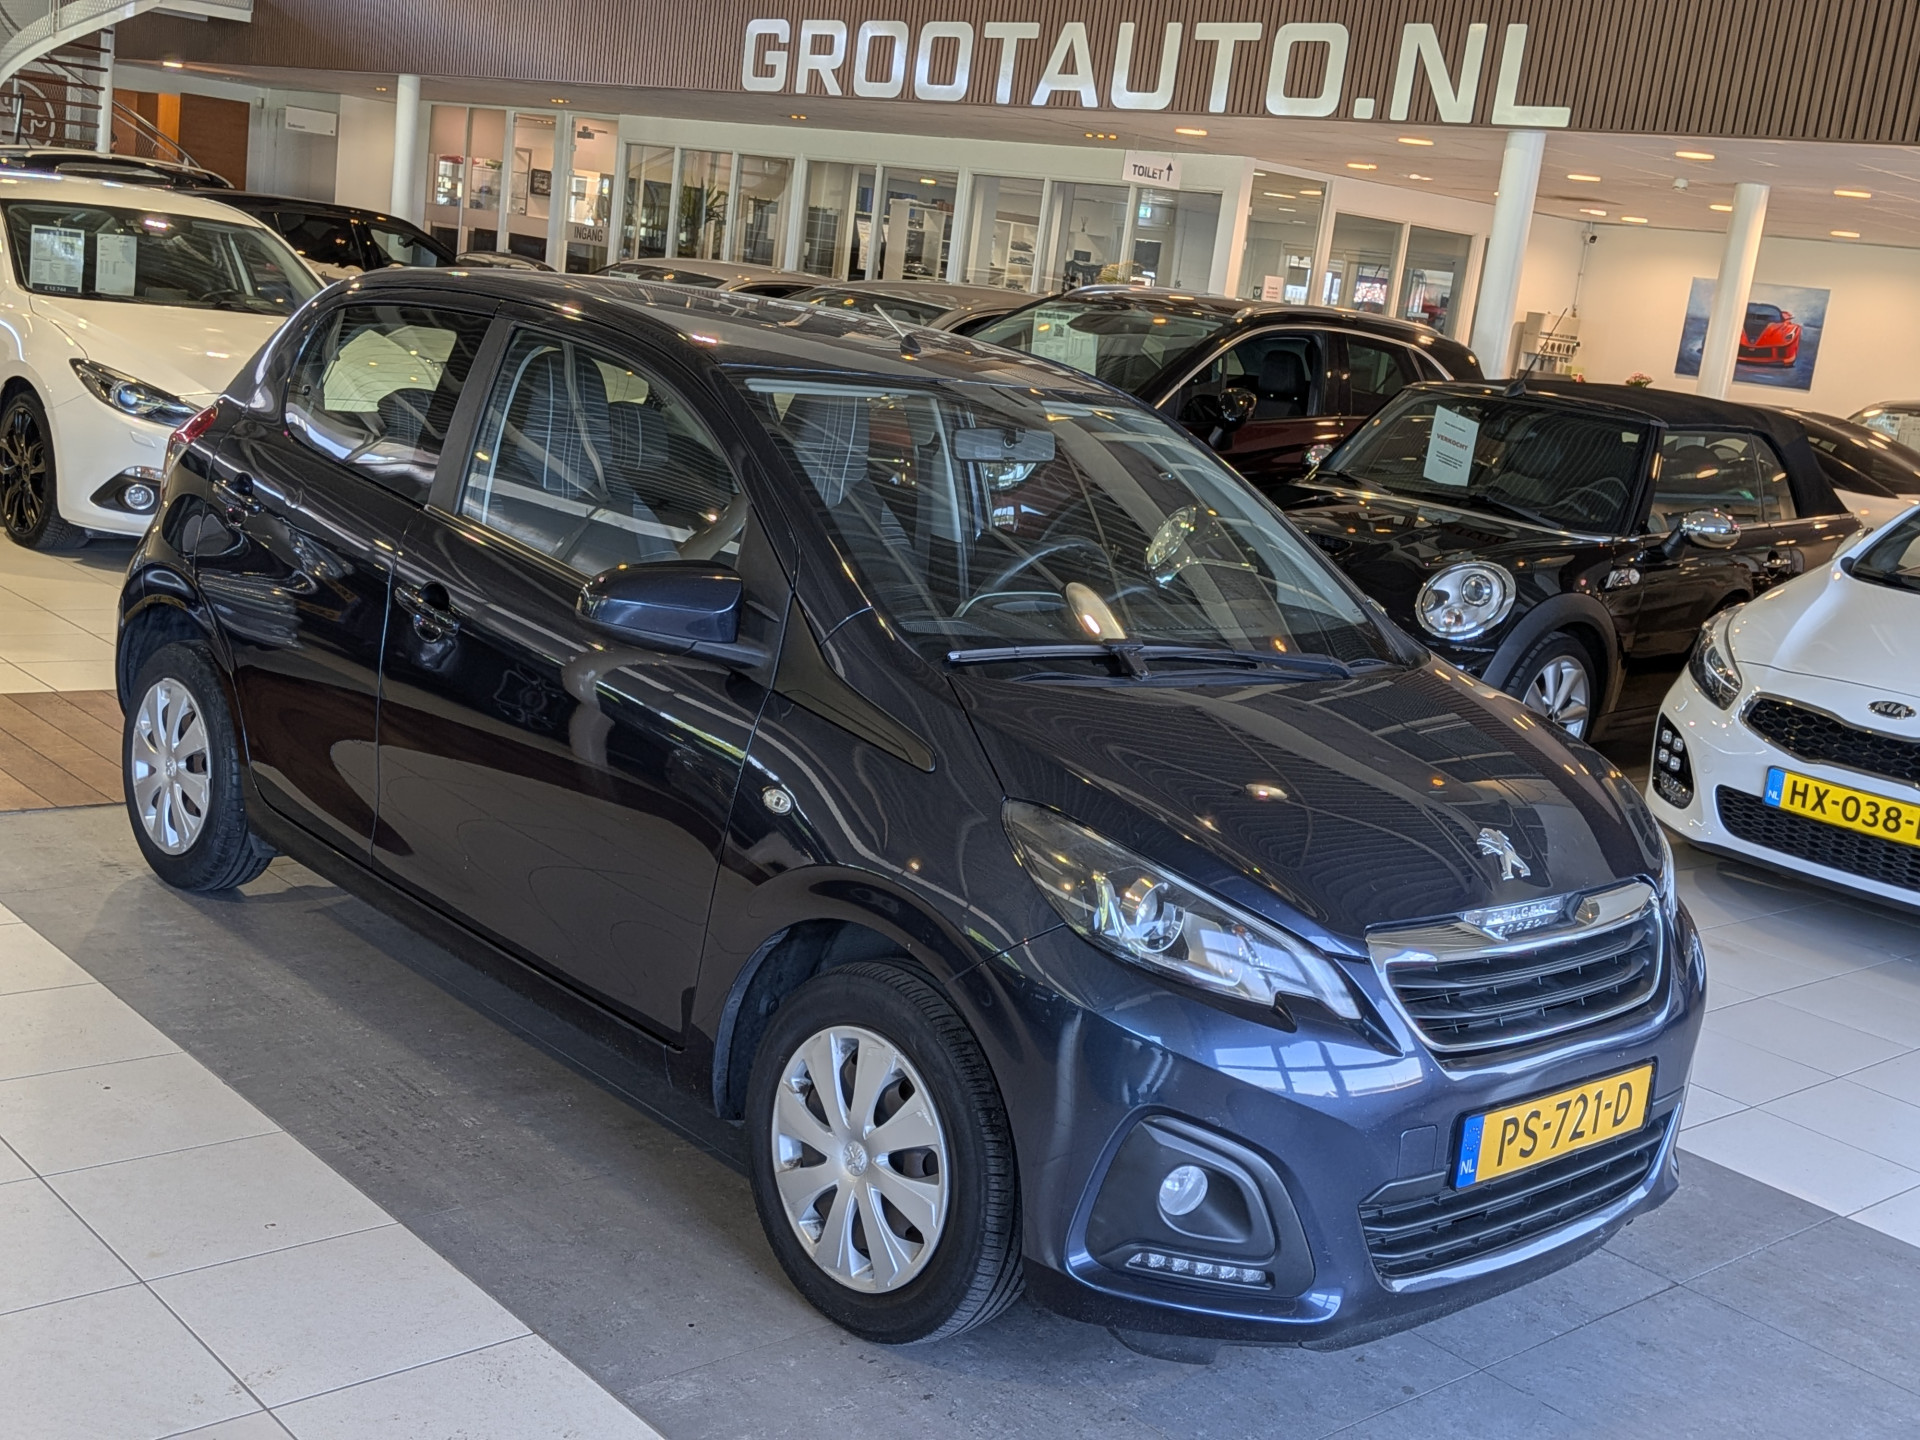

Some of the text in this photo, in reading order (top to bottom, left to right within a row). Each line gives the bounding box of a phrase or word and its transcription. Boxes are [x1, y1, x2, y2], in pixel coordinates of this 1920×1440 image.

[741, 18, 1571, 128] GROOTAUTO.NL
[1132, 163, 1164, 180] TOILET
[574, 226, 603, 242] INGANG
[1436, 433, 1469, 451] VERKOCHT
[1874, 701, 1907, 717] KIA
[1767, 789, 1780, 801] NL
[1789, 780, 1920, 841] HX-038-
[1496, 1081, 1633, 1168] PS-721-D
[1459, 1159, 1475, 1176] NL
